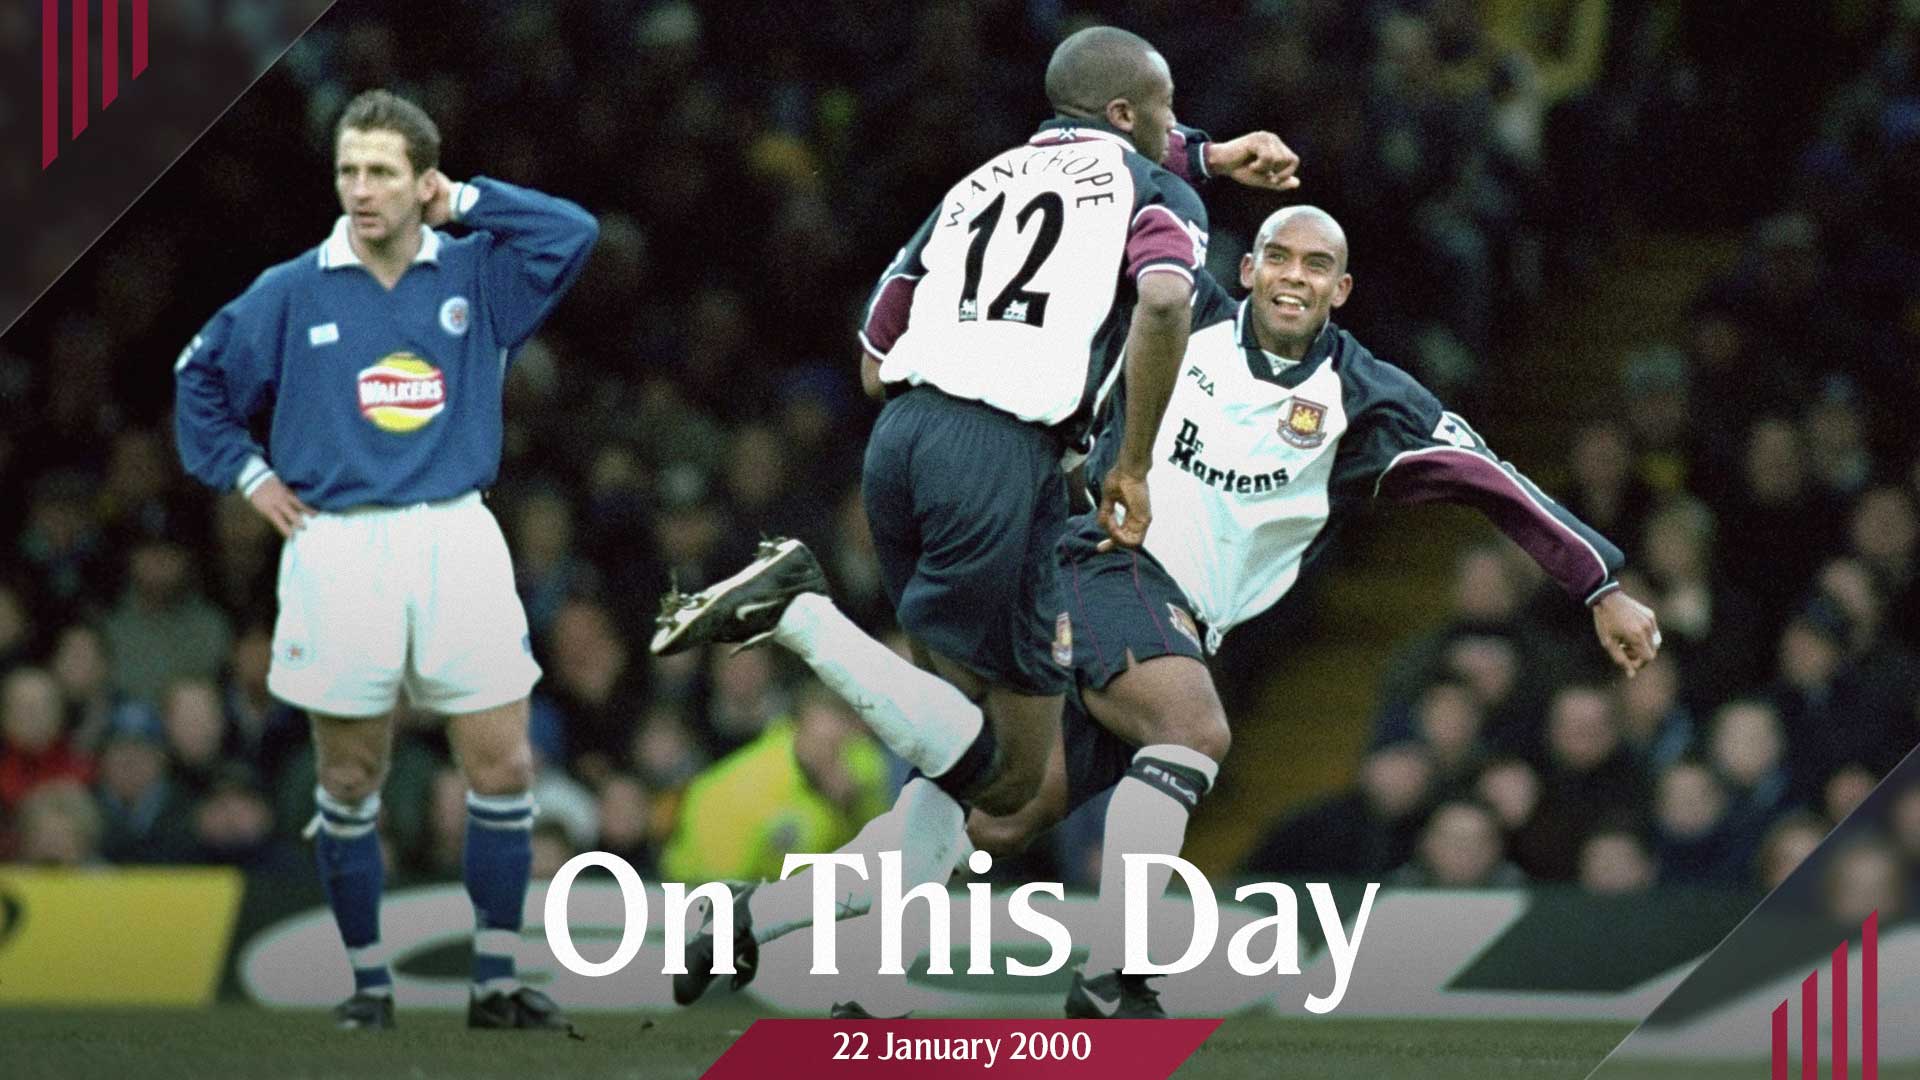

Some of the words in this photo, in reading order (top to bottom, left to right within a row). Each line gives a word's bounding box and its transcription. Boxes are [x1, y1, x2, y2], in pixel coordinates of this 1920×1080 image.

[945, 149, 1115, 228] WANCHOPE
[958, 190, 1065, 328] 12
[359, 379, 443, 404] WALKERS
[1168, 439, 1290, 494] Martens
